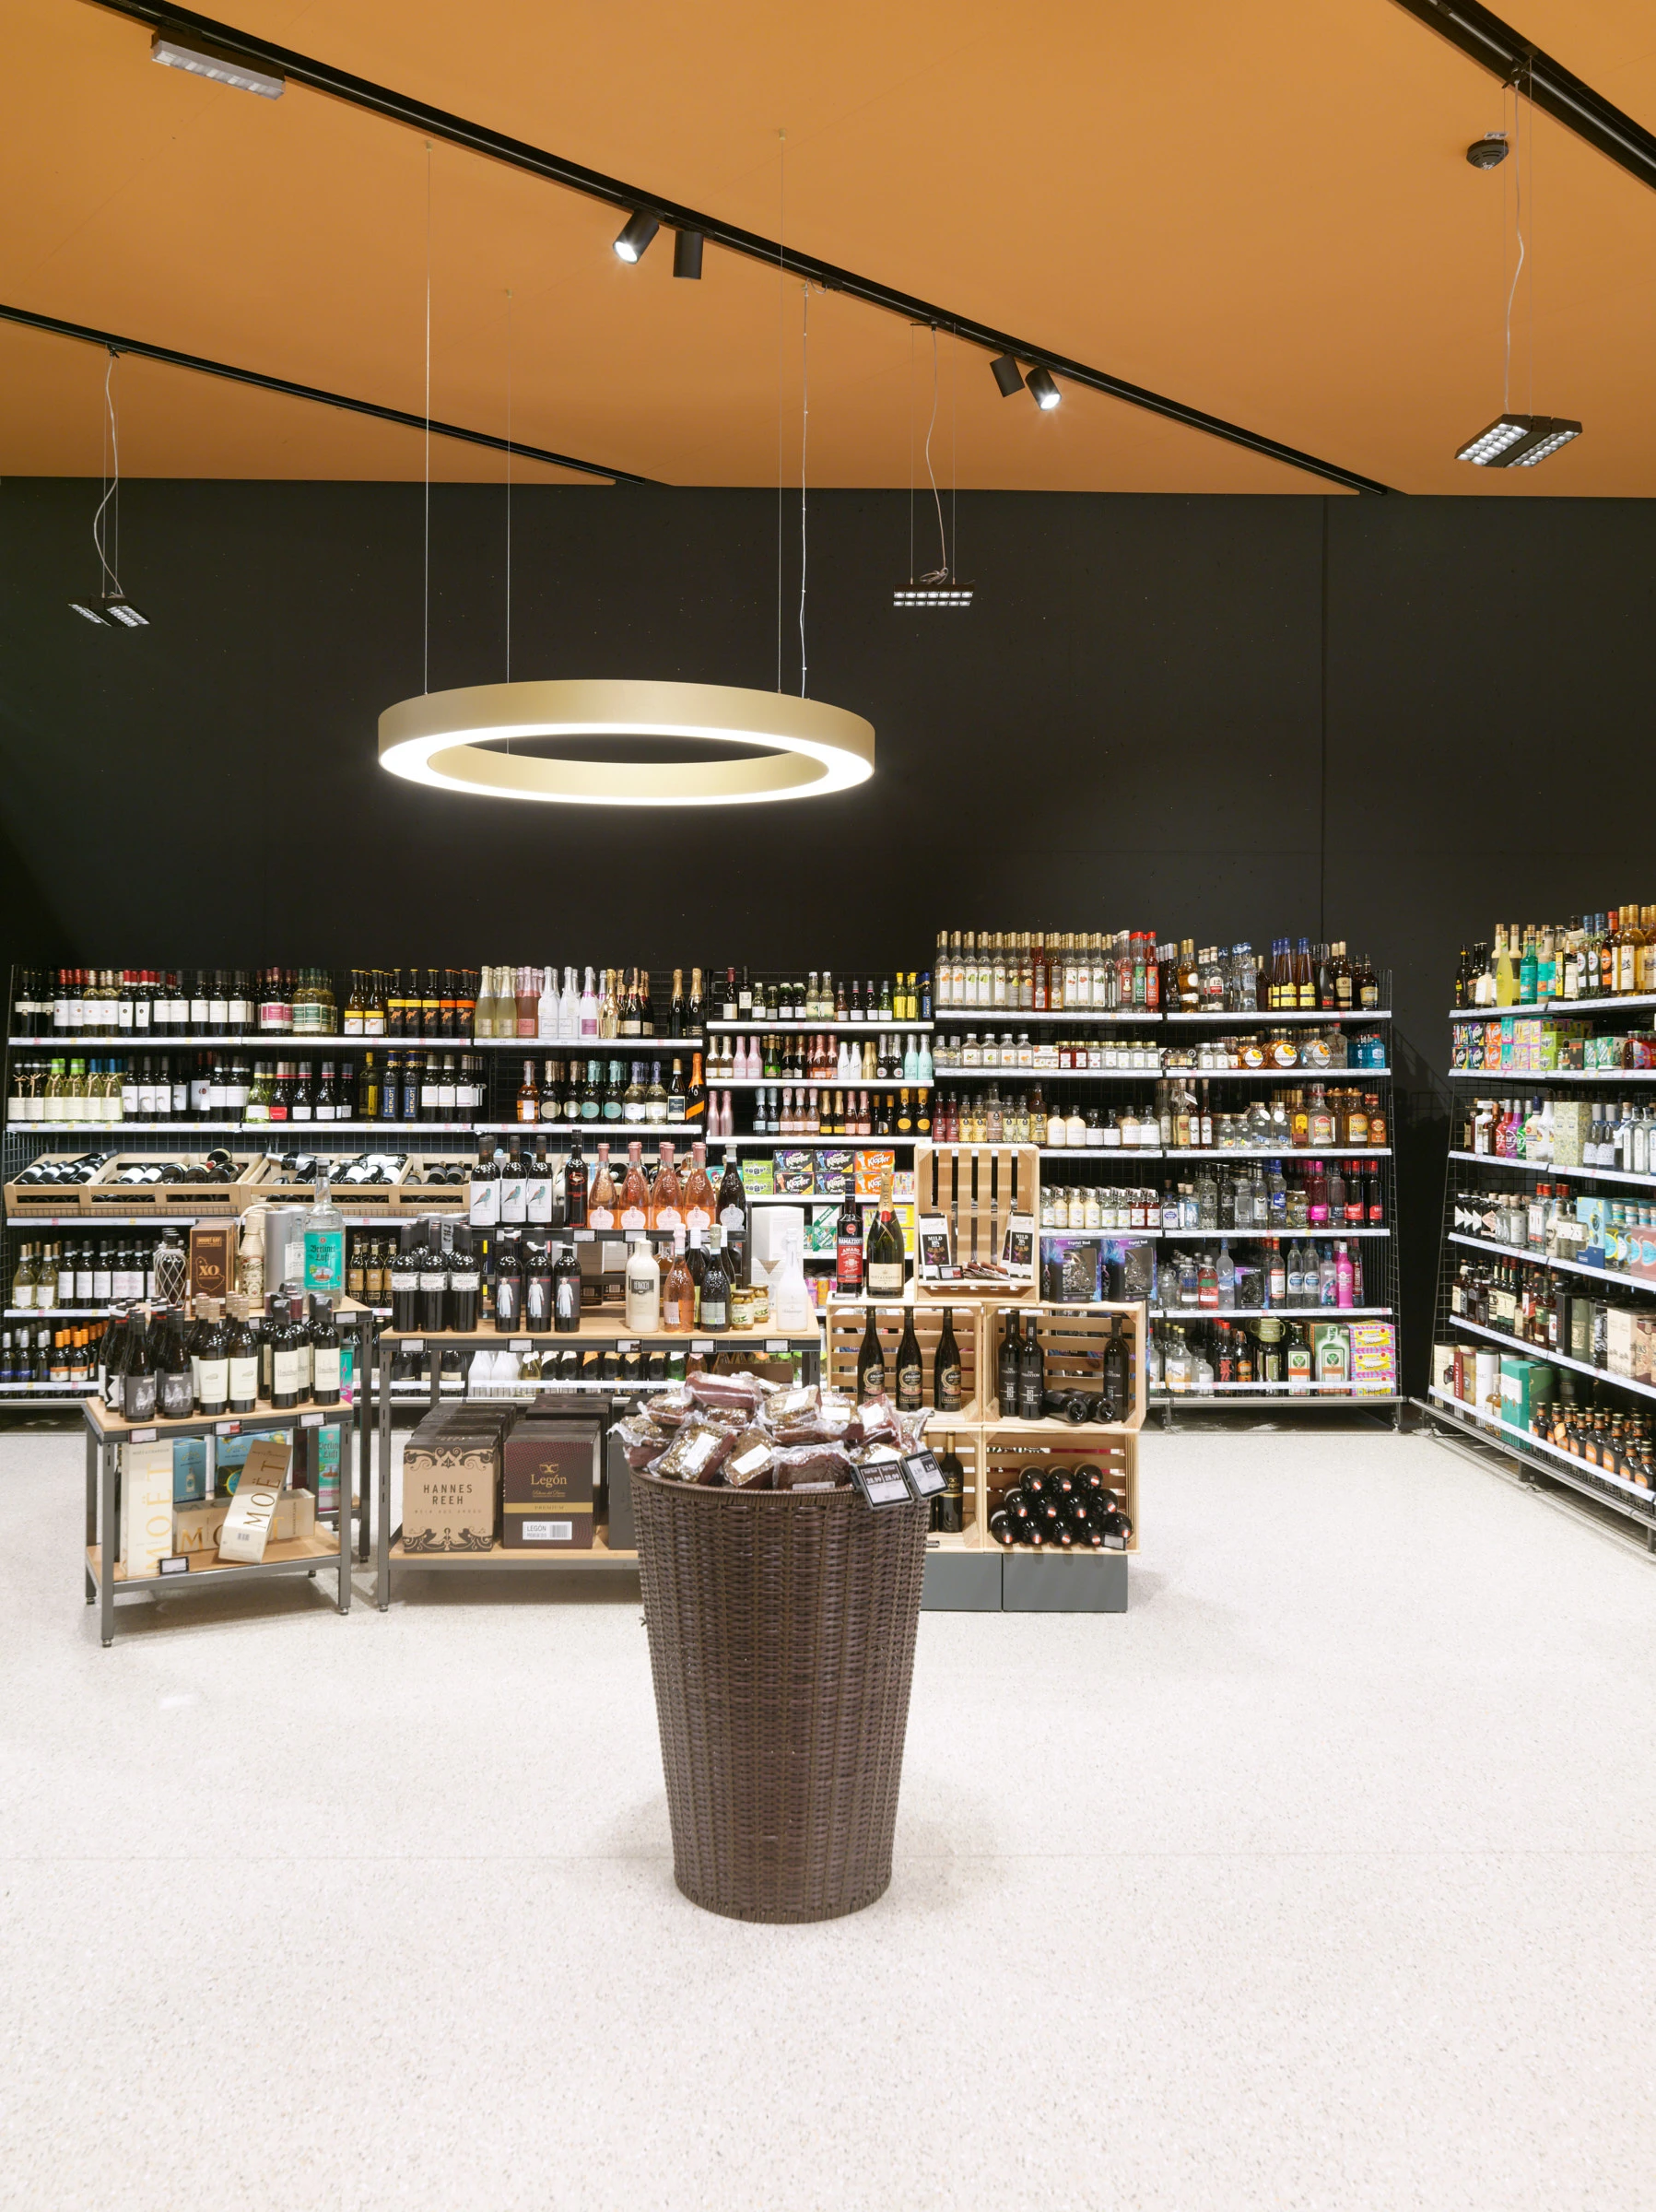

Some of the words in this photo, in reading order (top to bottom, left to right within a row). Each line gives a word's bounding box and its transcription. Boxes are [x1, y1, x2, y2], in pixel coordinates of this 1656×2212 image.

[199, 1265, 220, 1276] XO
[530, 1473, 568, 1488] Legón
[243, 1460, 285, 1530] MOËT
[423, 1484, 473, 1494] HANNES
[432, 1495, 464, 1505] REEH
[142, 1462, 173, 1571] MOËT
